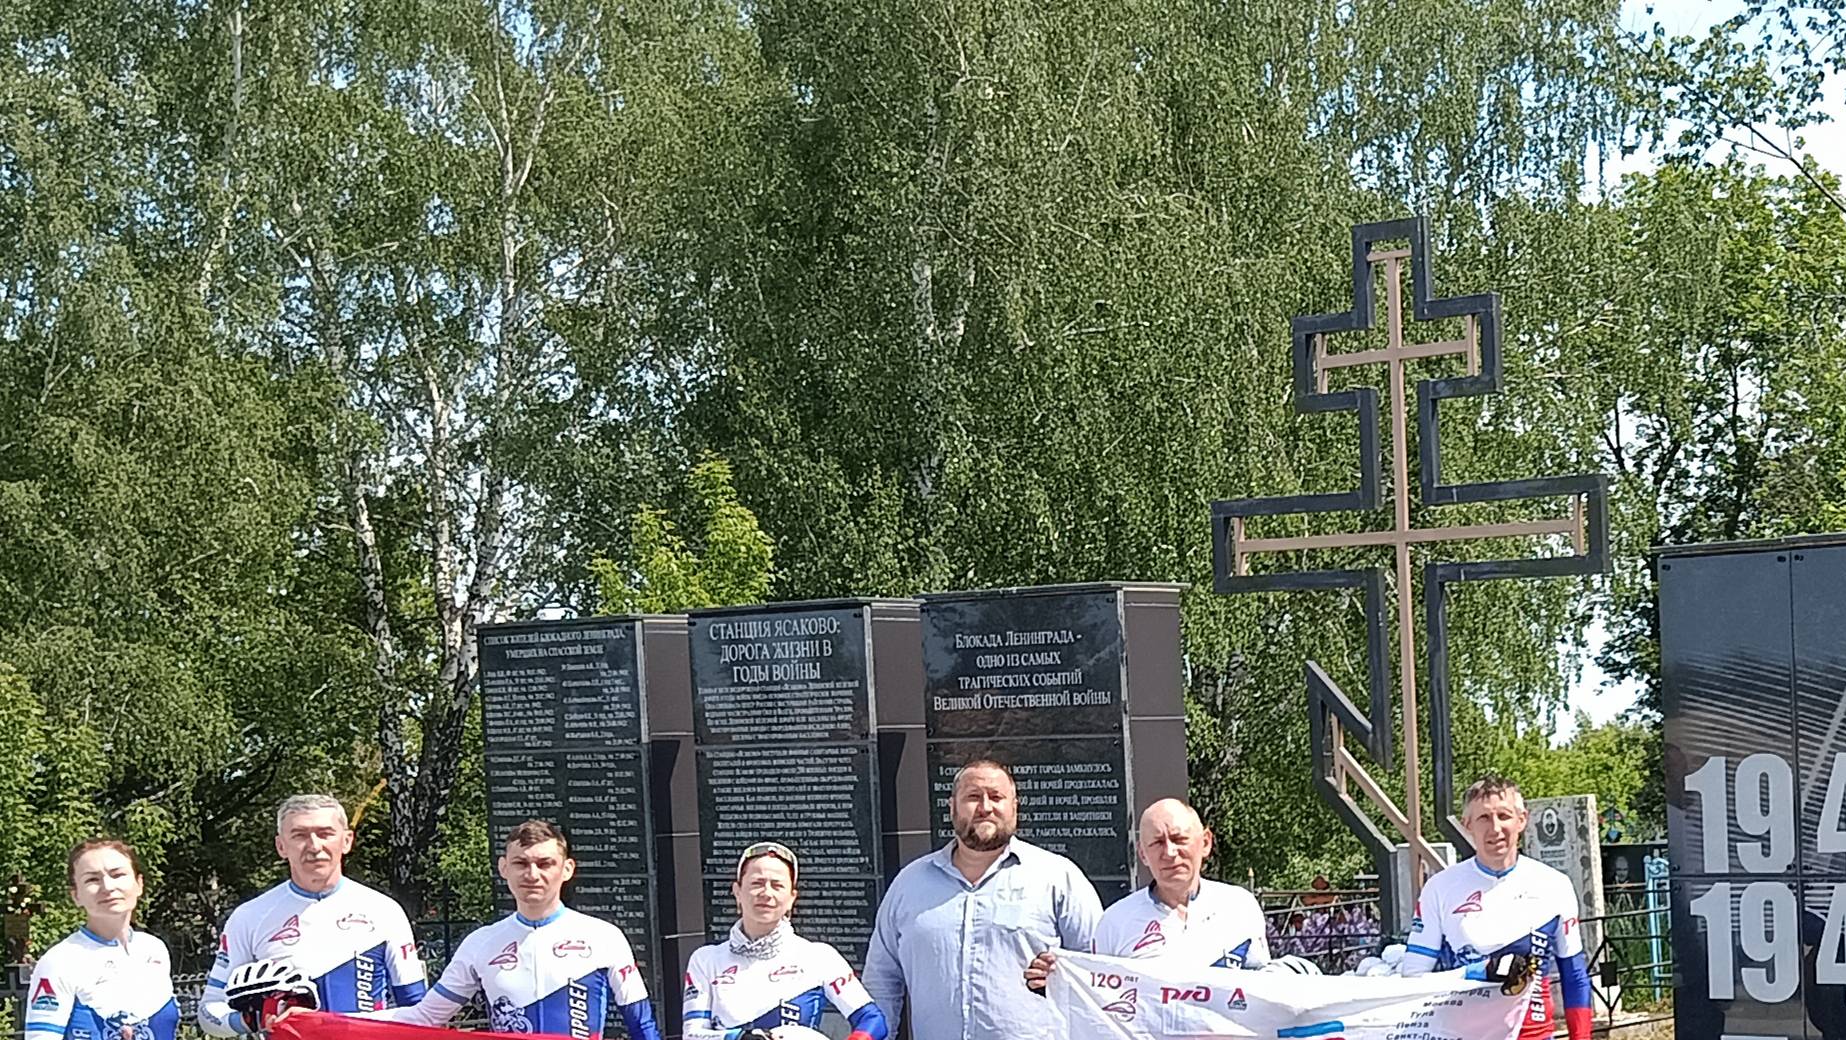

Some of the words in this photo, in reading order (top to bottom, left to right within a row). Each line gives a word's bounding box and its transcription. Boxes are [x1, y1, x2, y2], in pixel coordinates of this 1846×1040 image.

[709, 622, 771, 640] СТАНЦИЯ
[774, 616, 841, 637] ЯСАКОВО:
[720, 643, 770, 664] ДОРОГА
[773, 641, 820, 660] ЖИЗНИ
[823, 640, 832, 657] В
[976, 655, 1004, 668] ОДНО
[1006, 654, 1020, 666] ИЗ
[1021, 651, 1061, 665] САМЫХ
[733, 665, 769, 684] ГОДЫ
[772, 660, 820, 680] ВОЙНЫ
[958, 673, 1030, 690] ТРАГИЧЕСКИХ
[1032, 669, 1082, 686] СОБЫТИЙ
[1073, 689, 1111, 705] ВОЙНЫ
[1090, 972, 1122, 989] 120
